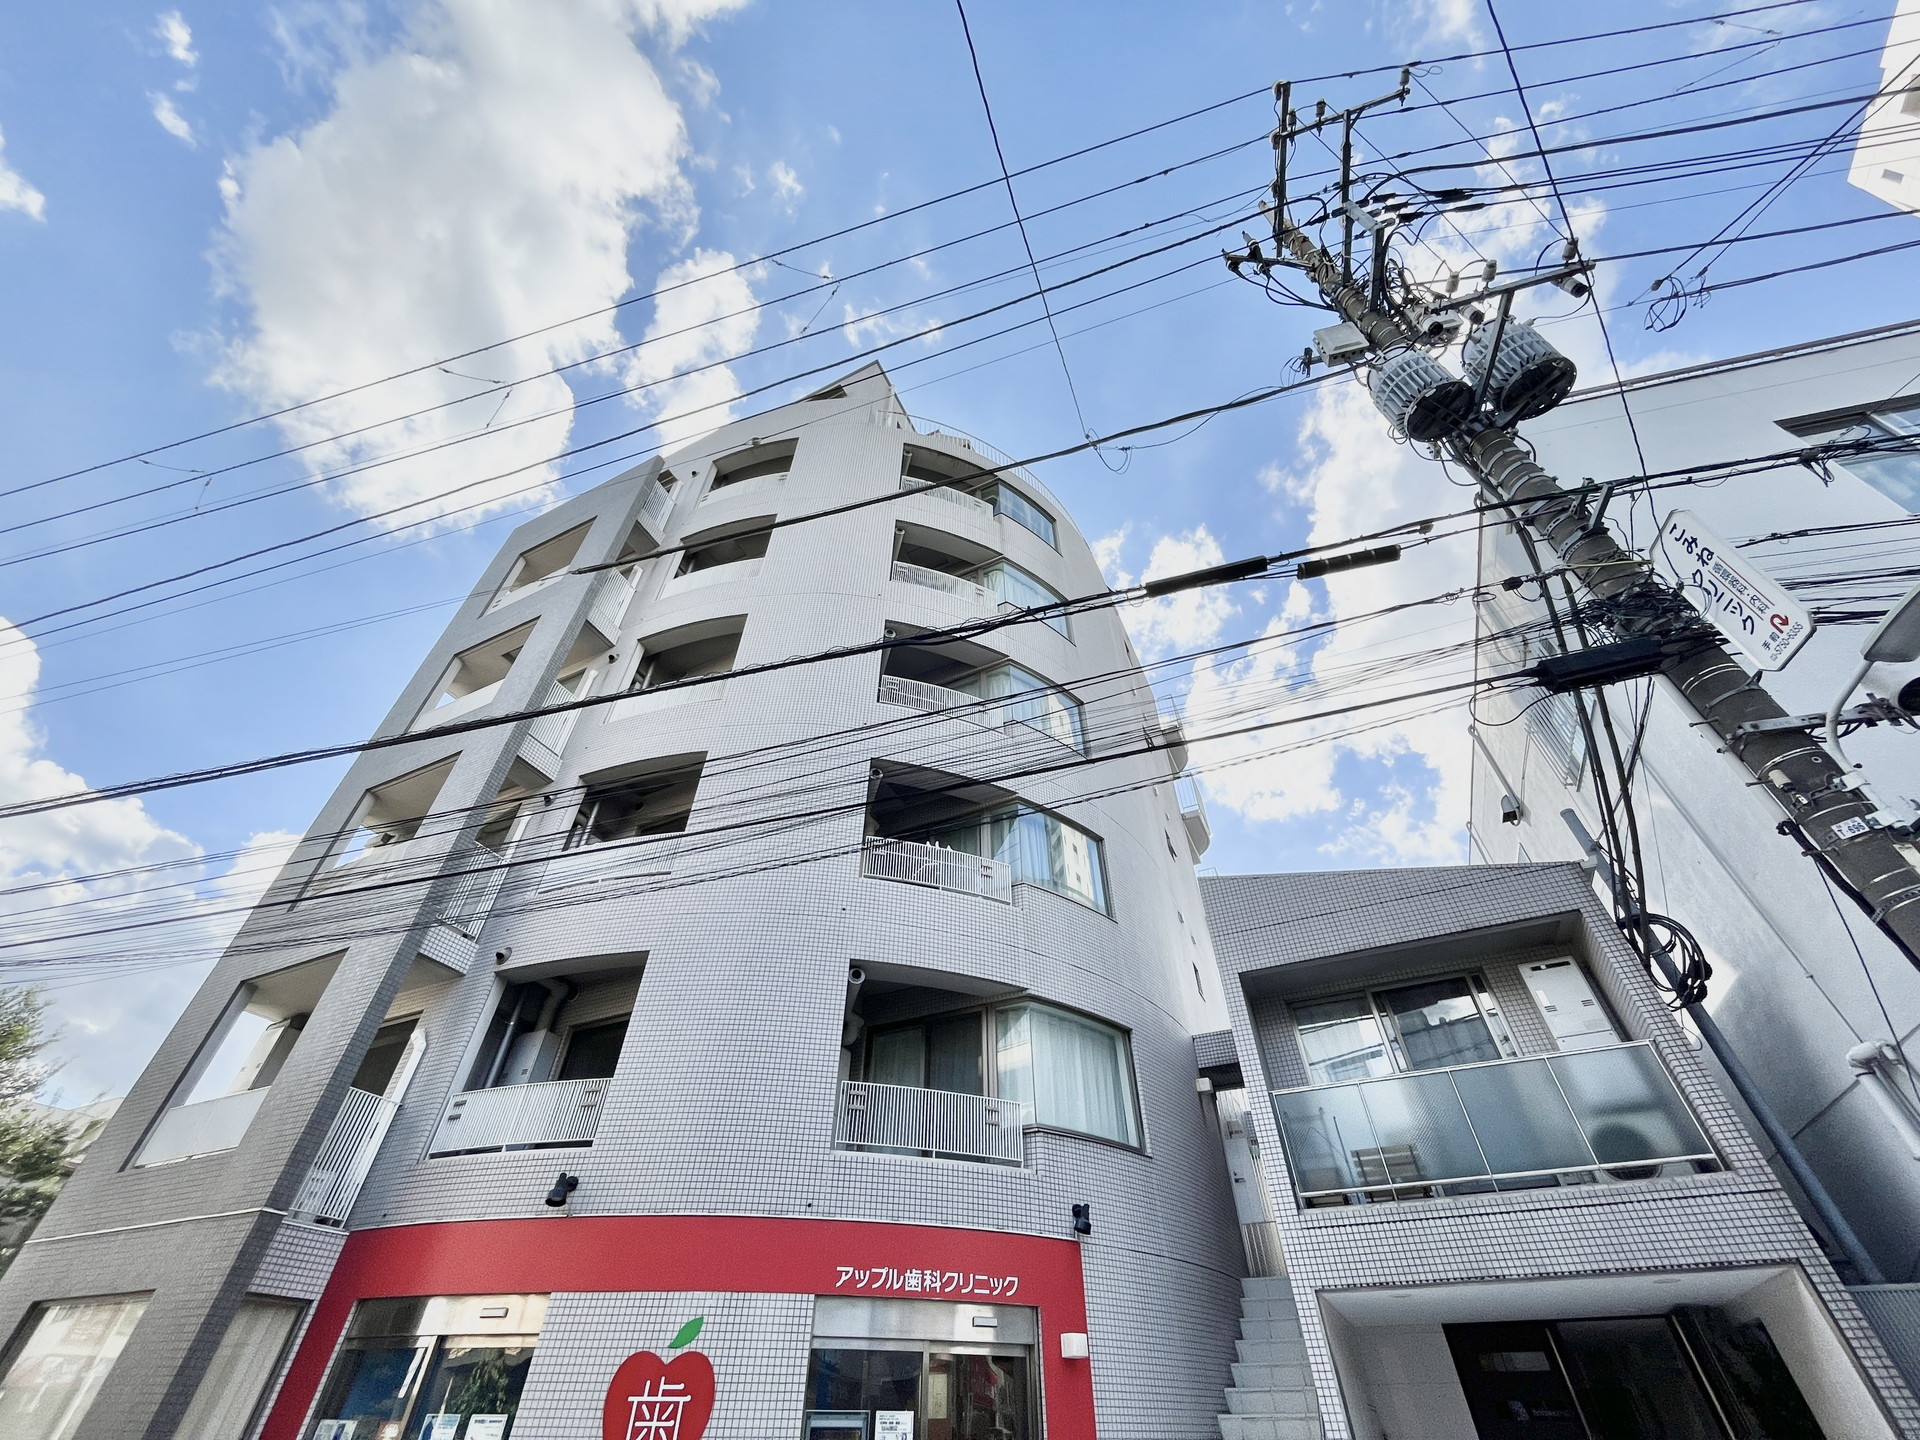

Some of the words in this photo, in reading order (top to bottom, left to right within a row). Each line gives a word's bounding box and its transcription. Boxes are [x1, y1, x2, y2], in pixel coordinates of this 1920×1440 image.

[1669, 523, 1714, 567] こみね
[1692, 569, 1755, 635] クリニック
[835, 1266, 1019, 1297] アップル歯科クリニック
